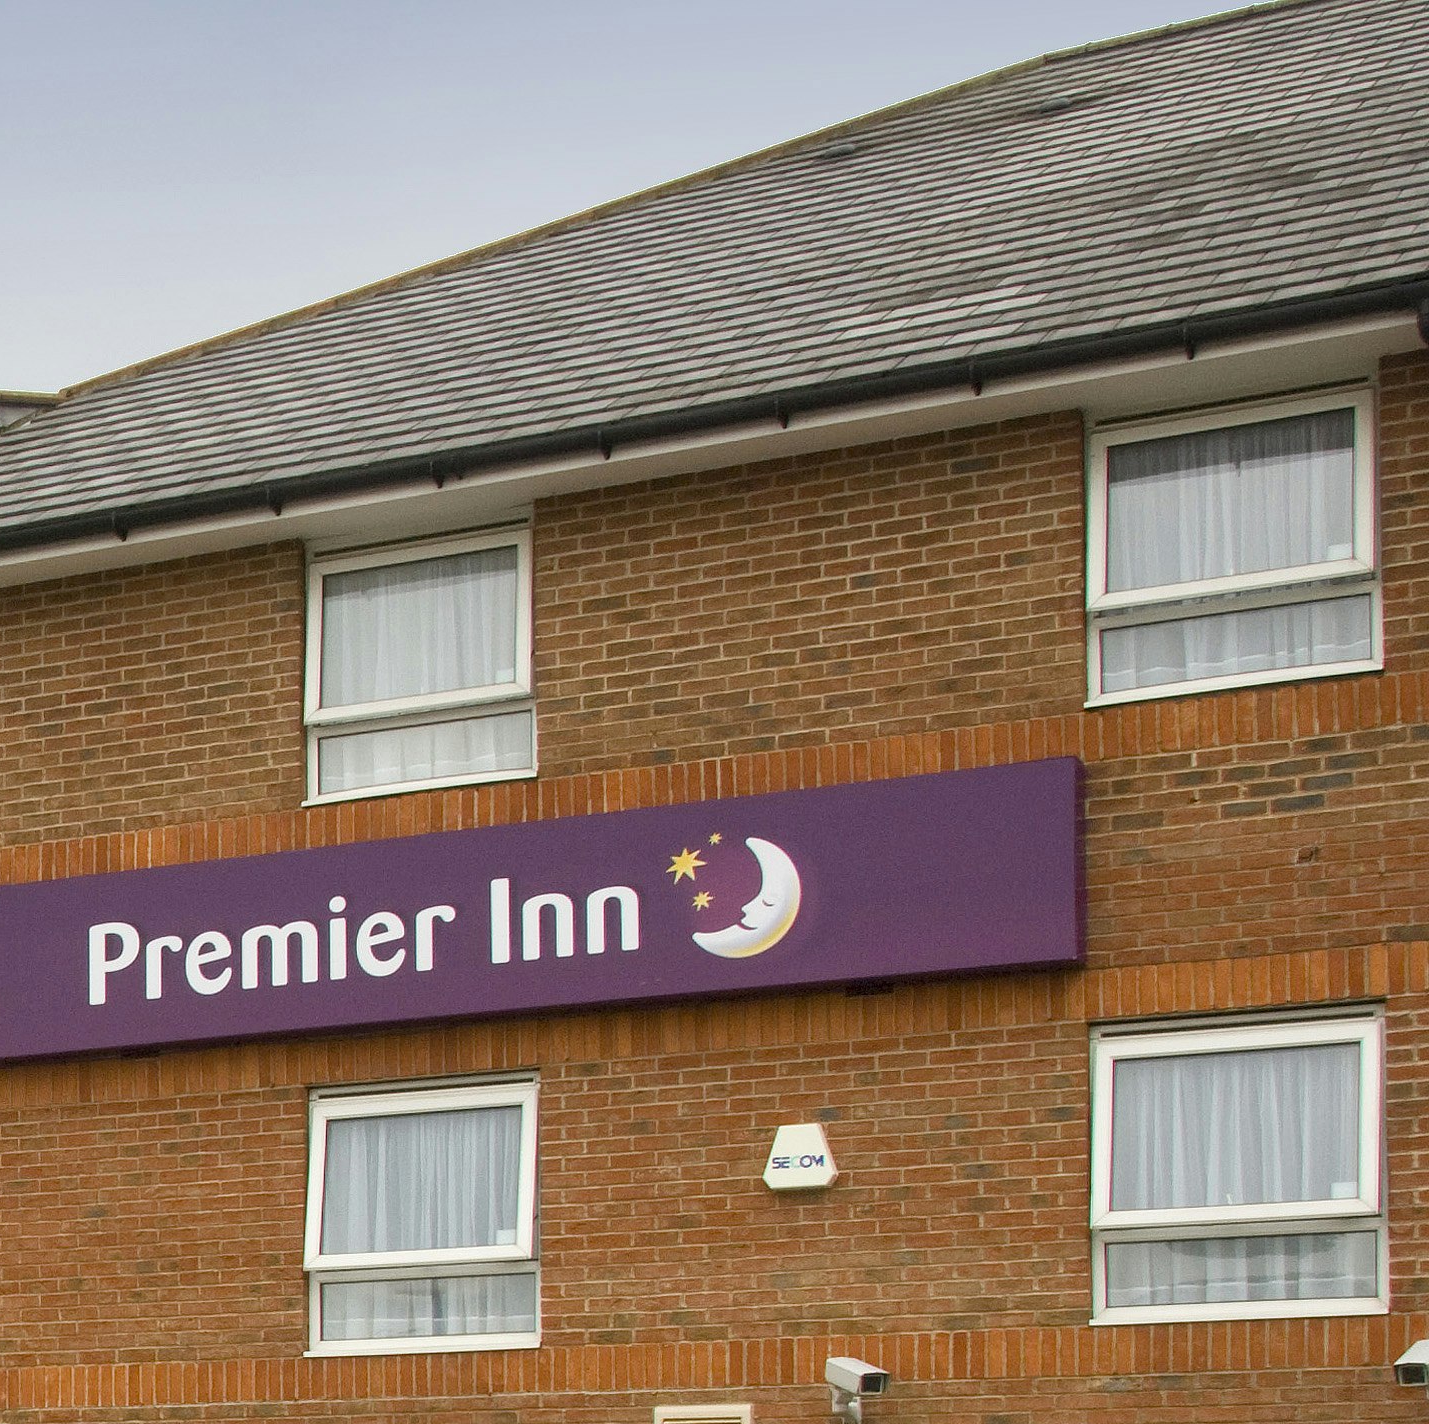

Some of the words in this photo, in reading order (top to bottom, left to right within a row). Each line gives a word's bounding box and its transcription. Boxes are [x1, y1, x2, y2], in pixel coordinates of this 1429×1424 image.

[87, 896, 457, 1006] Premier
[489, 876, 641, 967] Inn
[772, 1155, 826, 1169] SECOM
